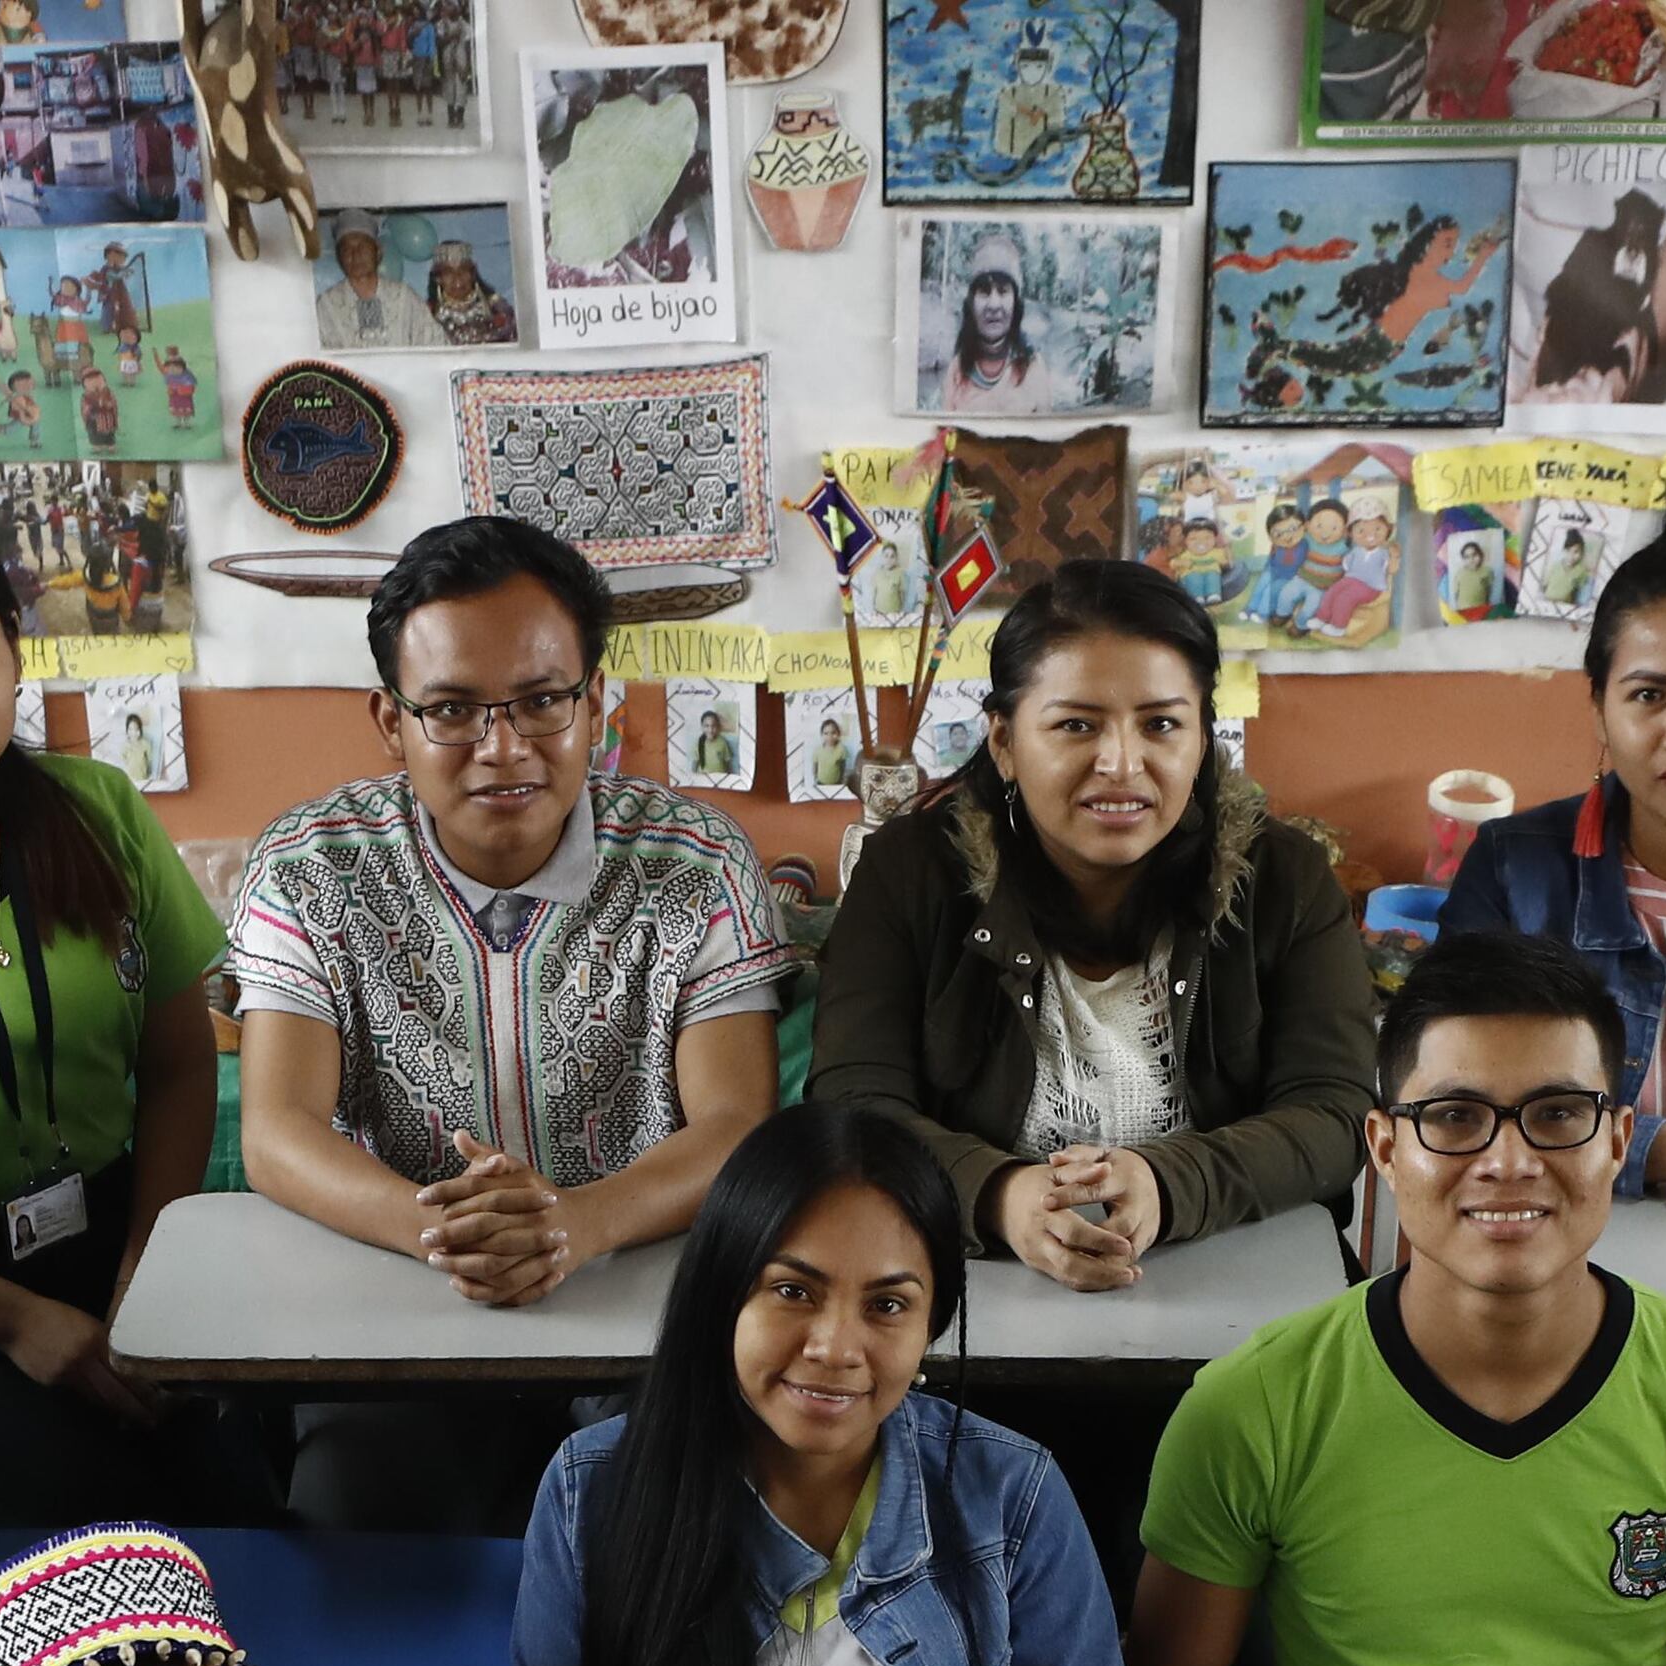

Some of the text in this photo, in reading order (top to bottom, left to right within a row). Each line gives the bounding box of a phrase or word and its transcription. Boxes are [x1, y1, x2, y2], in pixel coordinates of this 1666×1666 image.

[551, 290, 718, 338] Hoja de bijao
